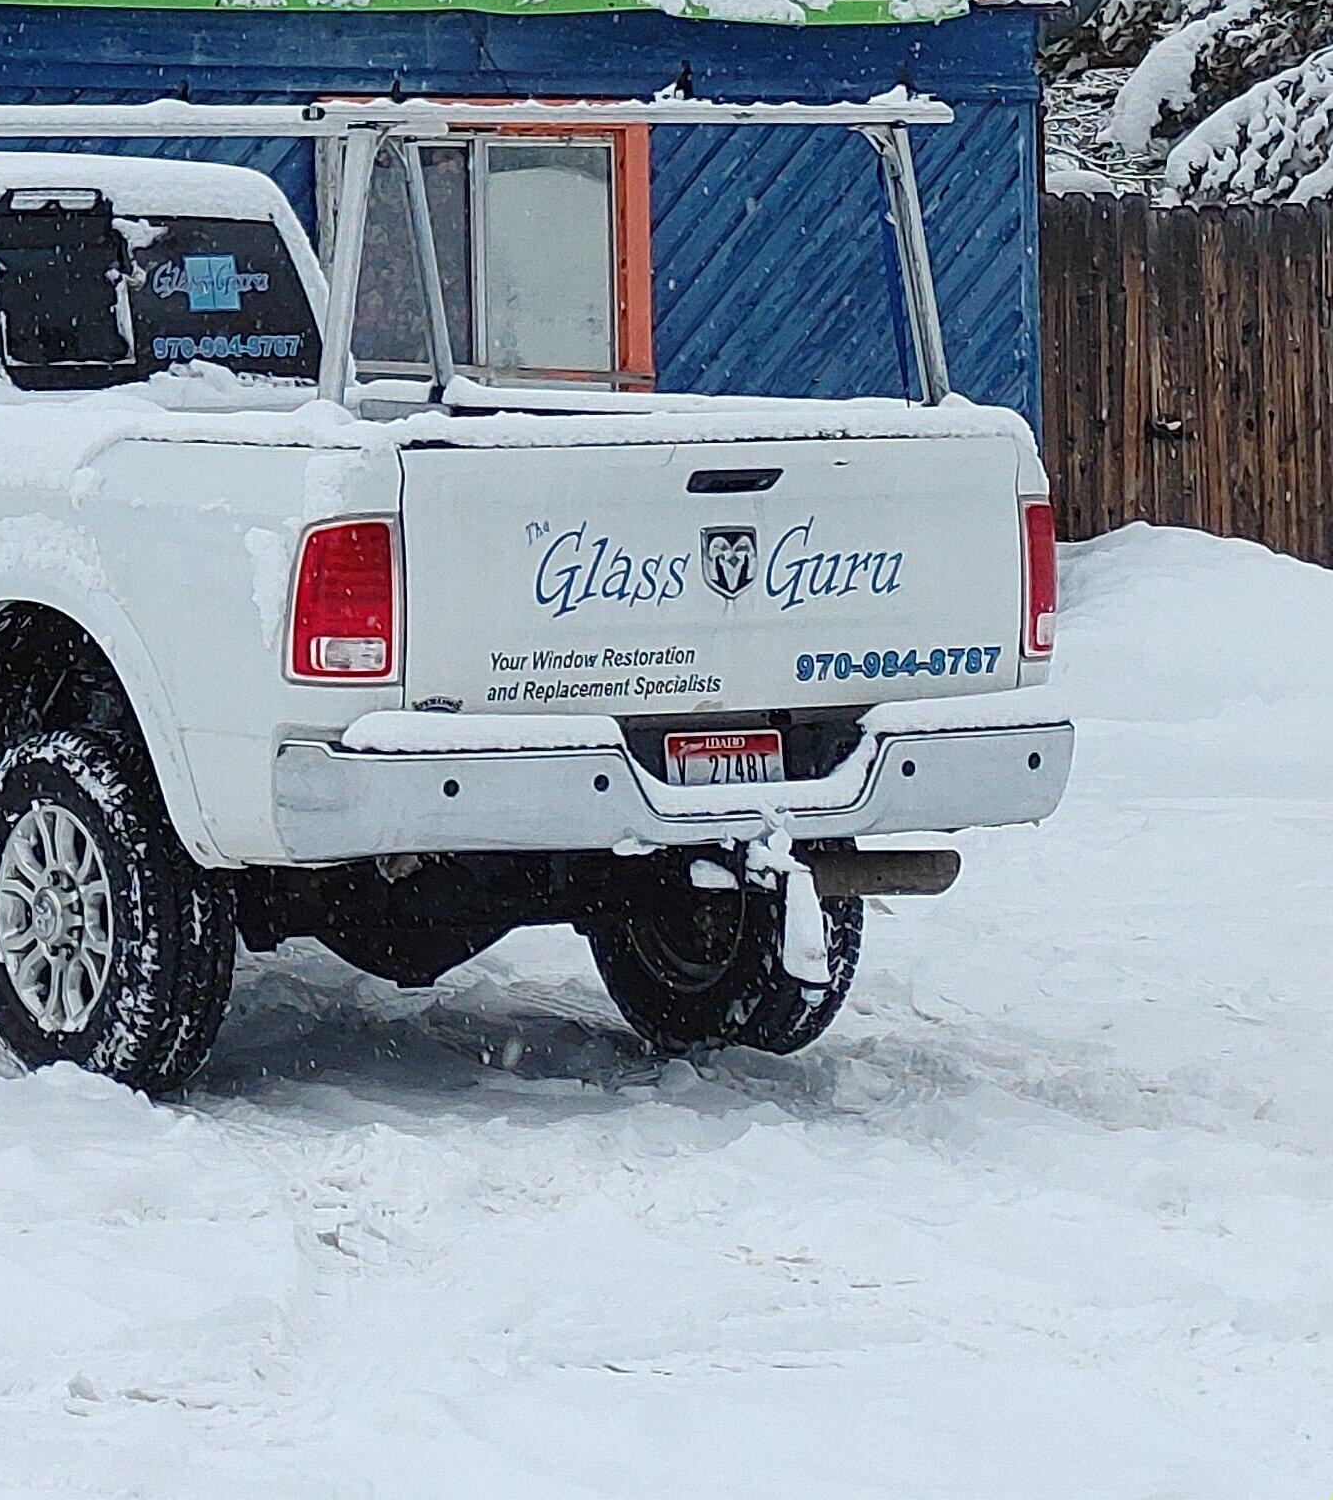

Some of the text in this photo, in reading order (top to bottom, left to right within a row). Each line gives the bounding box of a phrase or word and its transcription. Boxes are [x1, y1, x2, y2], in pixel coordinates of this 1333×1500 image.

[535, 519, 691, 618] Glass
[764, 515, 904, 613] Guru
[491, 646, 695, 672] Your Window Restoration
[796, 647, 1001, 682] 970-984-8787
[487, 674, 722, 703] and Replacement Specialists
[705, 737, 746, 749] IDAHO
[675, 753, 770, 785] V 2748T
